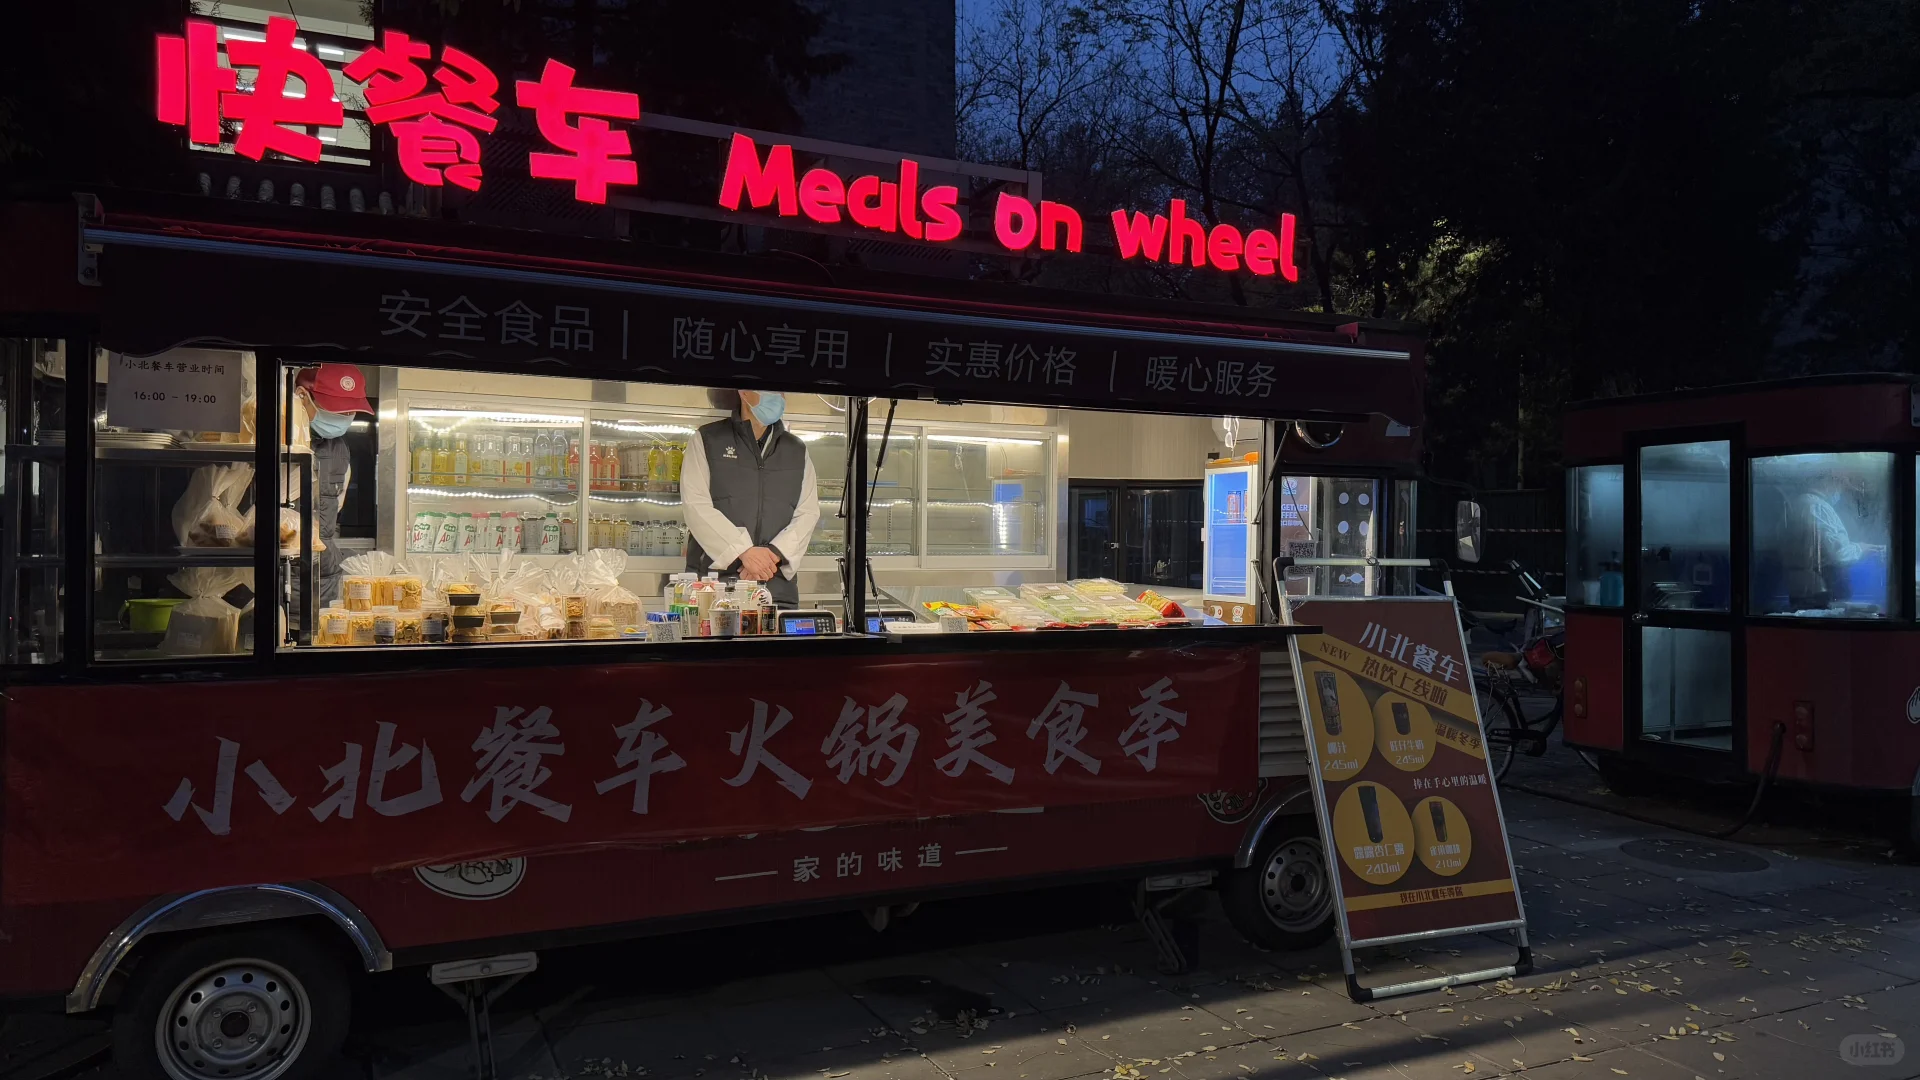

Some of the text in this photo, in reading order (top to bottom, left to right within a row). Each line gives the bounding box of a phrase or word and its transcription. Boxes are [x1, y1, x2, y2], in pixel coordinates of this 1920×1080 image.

[156, 15, 641, 205] 快餐车
[719, 131, 1298, 282] Meals on wheel
[379, 289, 1278, 398] 安全食品 随心享用 实惠价格 暖心服务
[124, 358, 226, 376] 小北餐车营业时间
[133, 390, 166, 402] 16:00
[184, 392, 217, 404] 19:00
[1359, 621, 1464, 682] 小北餐车
[1320, 641, 1448, 707] NEW 热饮上线啦
[1434, 721, 1482, 750] 温暖冬季
[162, 675, 1188, 836] 小北餐车火锅美食季
[1324, 759, 1359, 771] 245ml
[1395, 754, 1425, 765] 245ml
[1413, 774, 1487, 790] 捧在手心里的温暖
[793, 842, 943, 883] 家的味道
[1365, 861, 1401, 875] 240ml
[1435, 858, 1462, 869] 210ml
